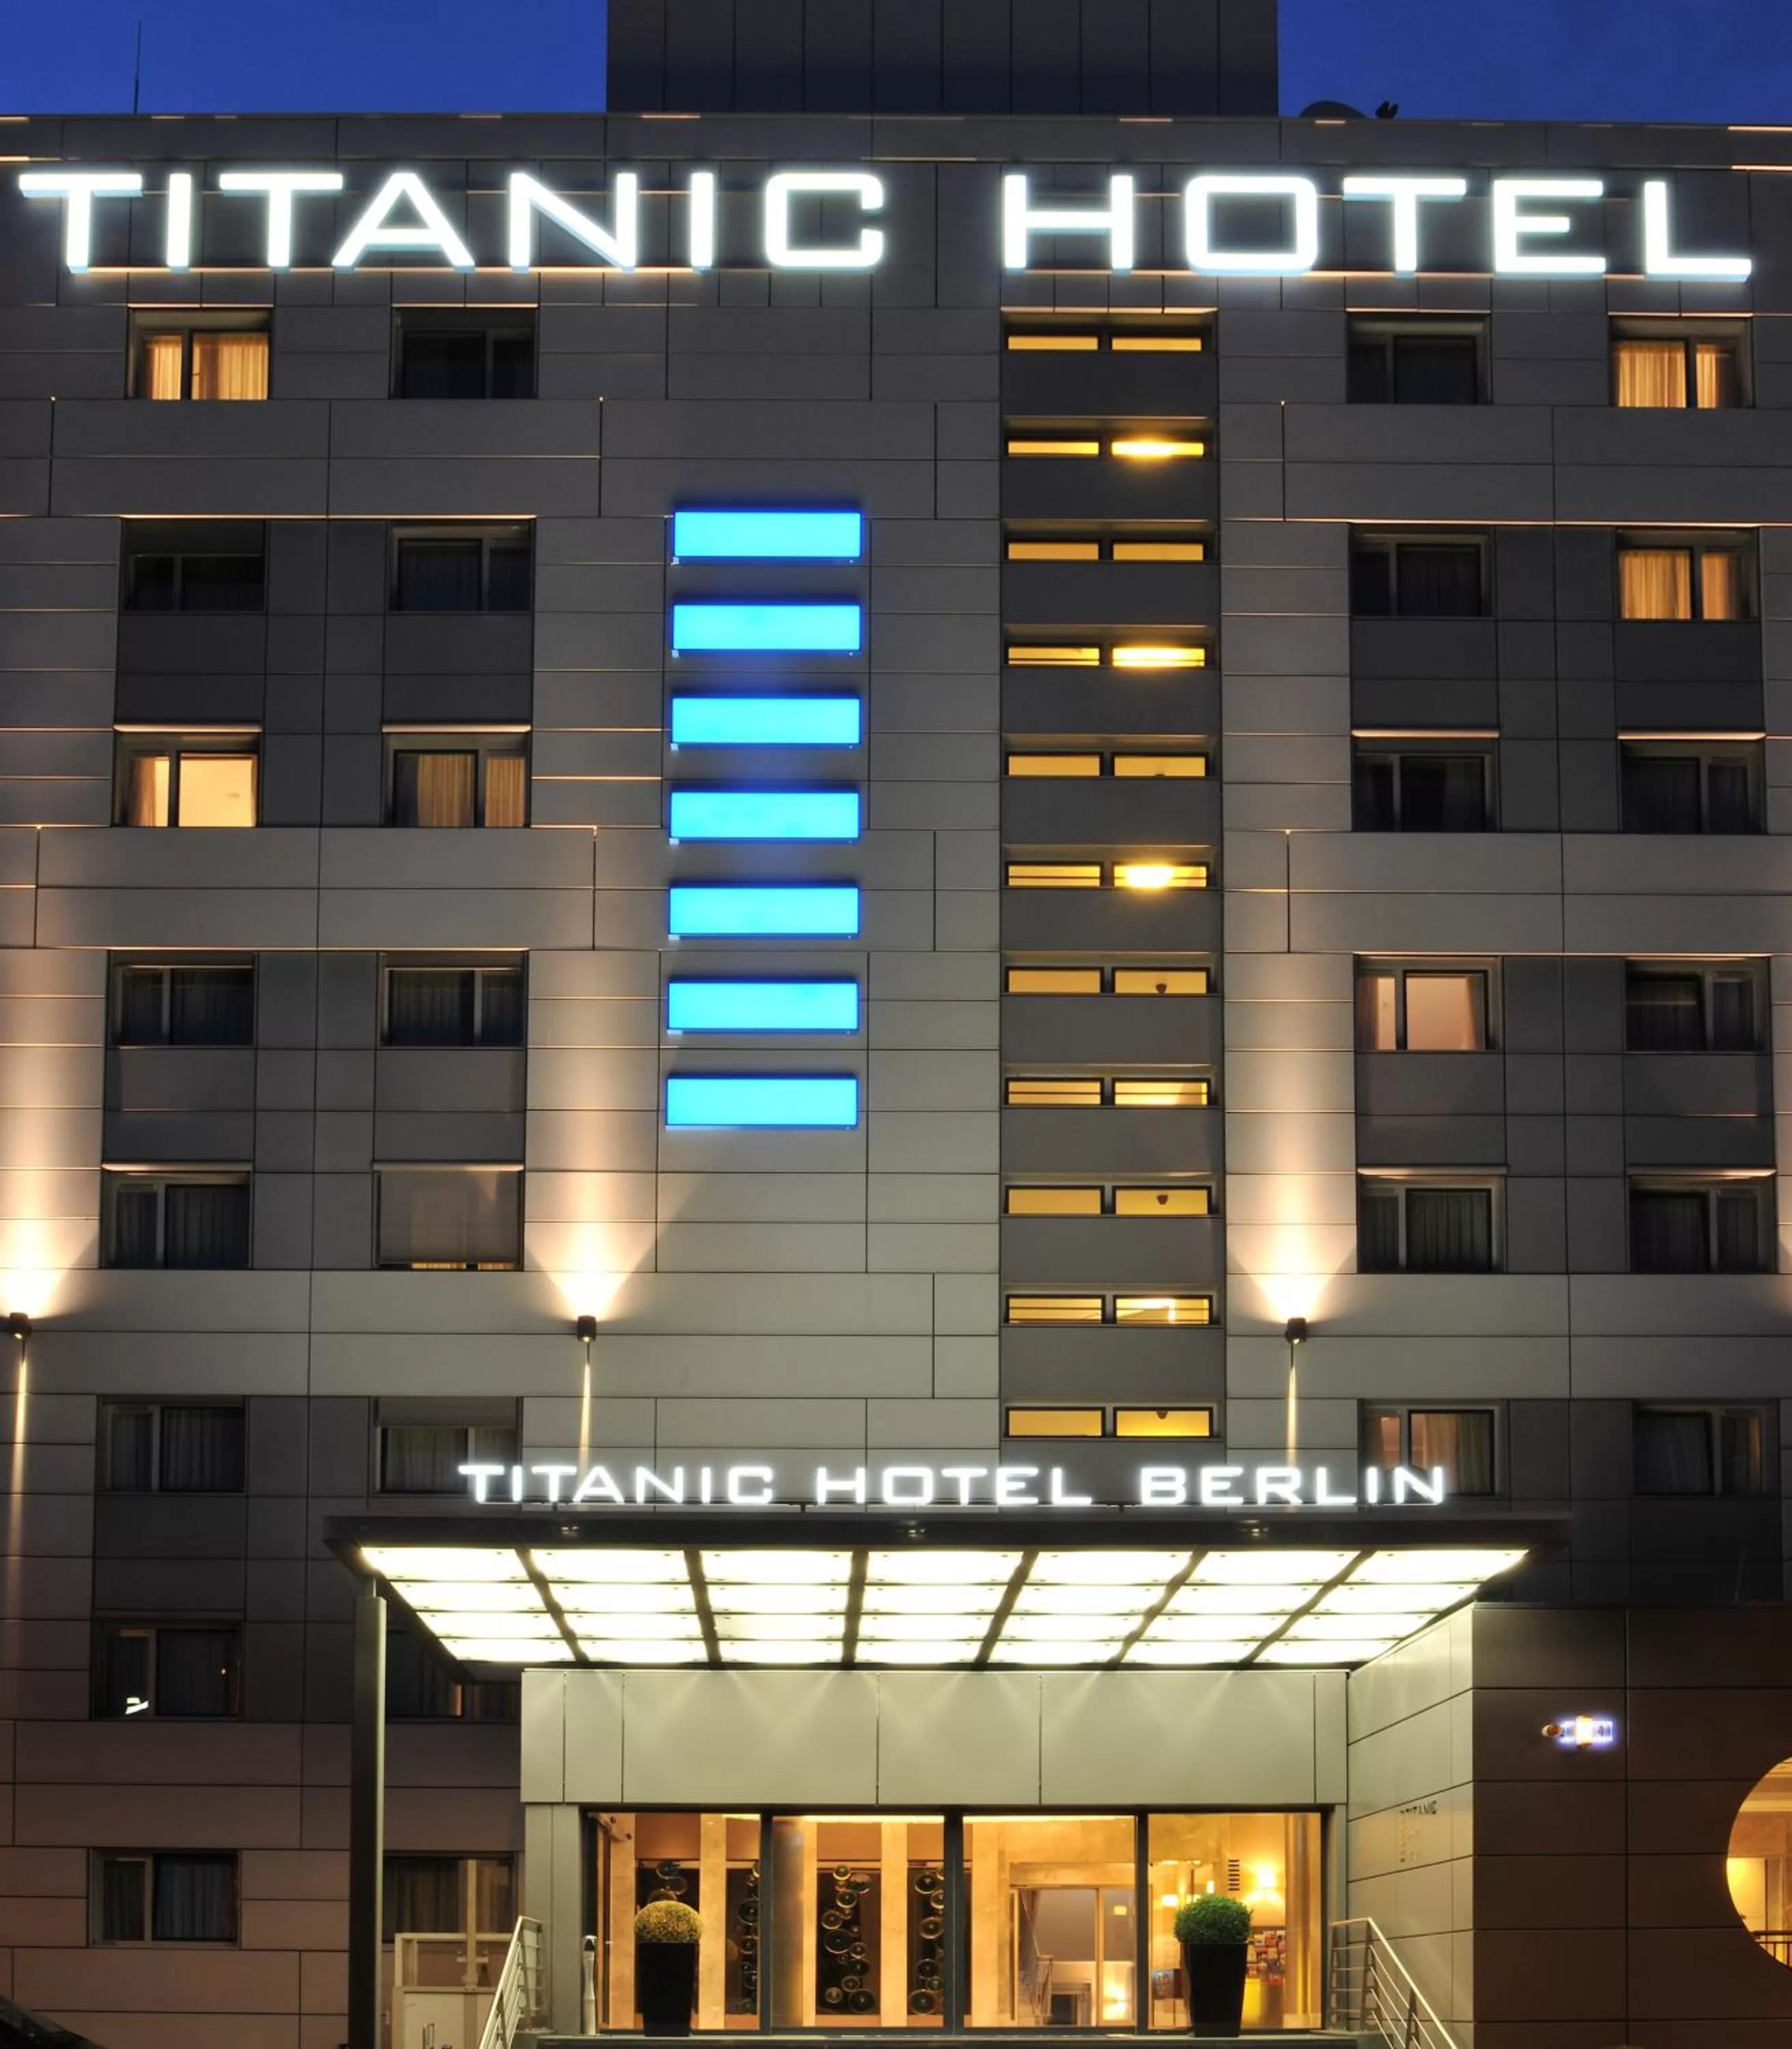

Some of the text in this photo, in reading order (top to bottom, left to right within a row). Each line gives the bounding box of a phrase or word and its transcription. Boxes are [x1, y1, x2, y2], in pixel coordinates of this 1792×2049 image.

[18, 169, 1754, 283] TITANIC HOTEL
[458, 1464, 1445, 1506] TITANIC HOTEL BERLIN
